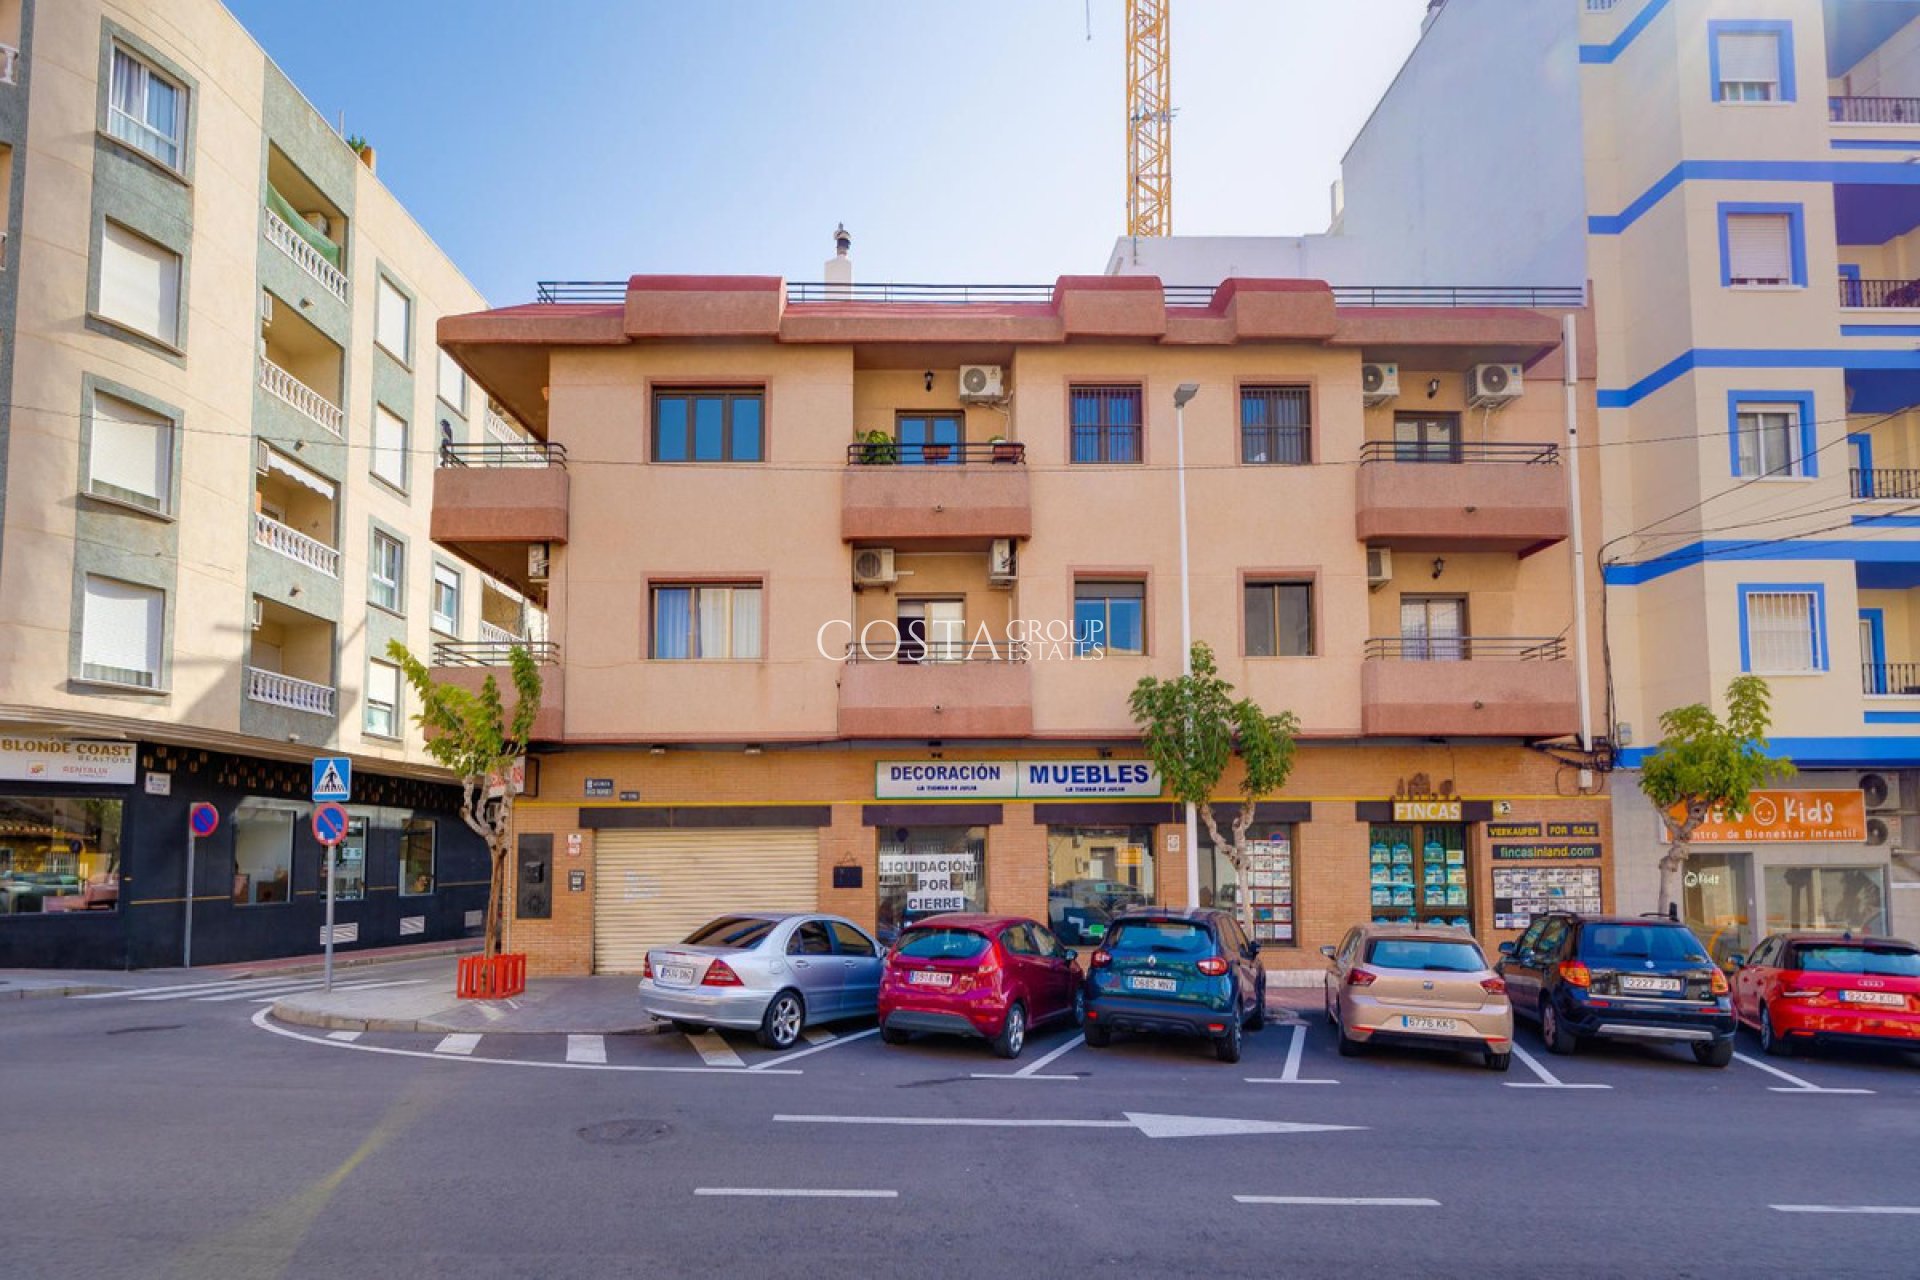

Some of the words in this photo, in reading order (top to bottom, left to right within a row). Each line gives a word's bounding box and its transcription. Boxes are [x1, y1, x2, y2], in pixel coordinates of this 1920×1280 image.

[2, 739, 71, 752] BLONDE
[76, 743, 132, 756] COAST
[78, 755, 132, 764] REALTORS
[890, 763, 1000, 781] DECORACIÓN
[1030, 765, 1149, 785] MUEBLES
[1394, 803, 1461, 819] FINCAS
[1784, 796, 1834, 824] Kids
[1549, 826, 1567, 835] FOR
[1572, 826, 1595, 835] SALE
[1745, 829, 1806, 839] Bienestar
[1500, 846, 1595, 857] fincasinland.com
[880, 860, 972, 873] LIQUIDACIÓN
[919, 880, 948, 890] POR
[908, 898, 961, 910] CIERRE
